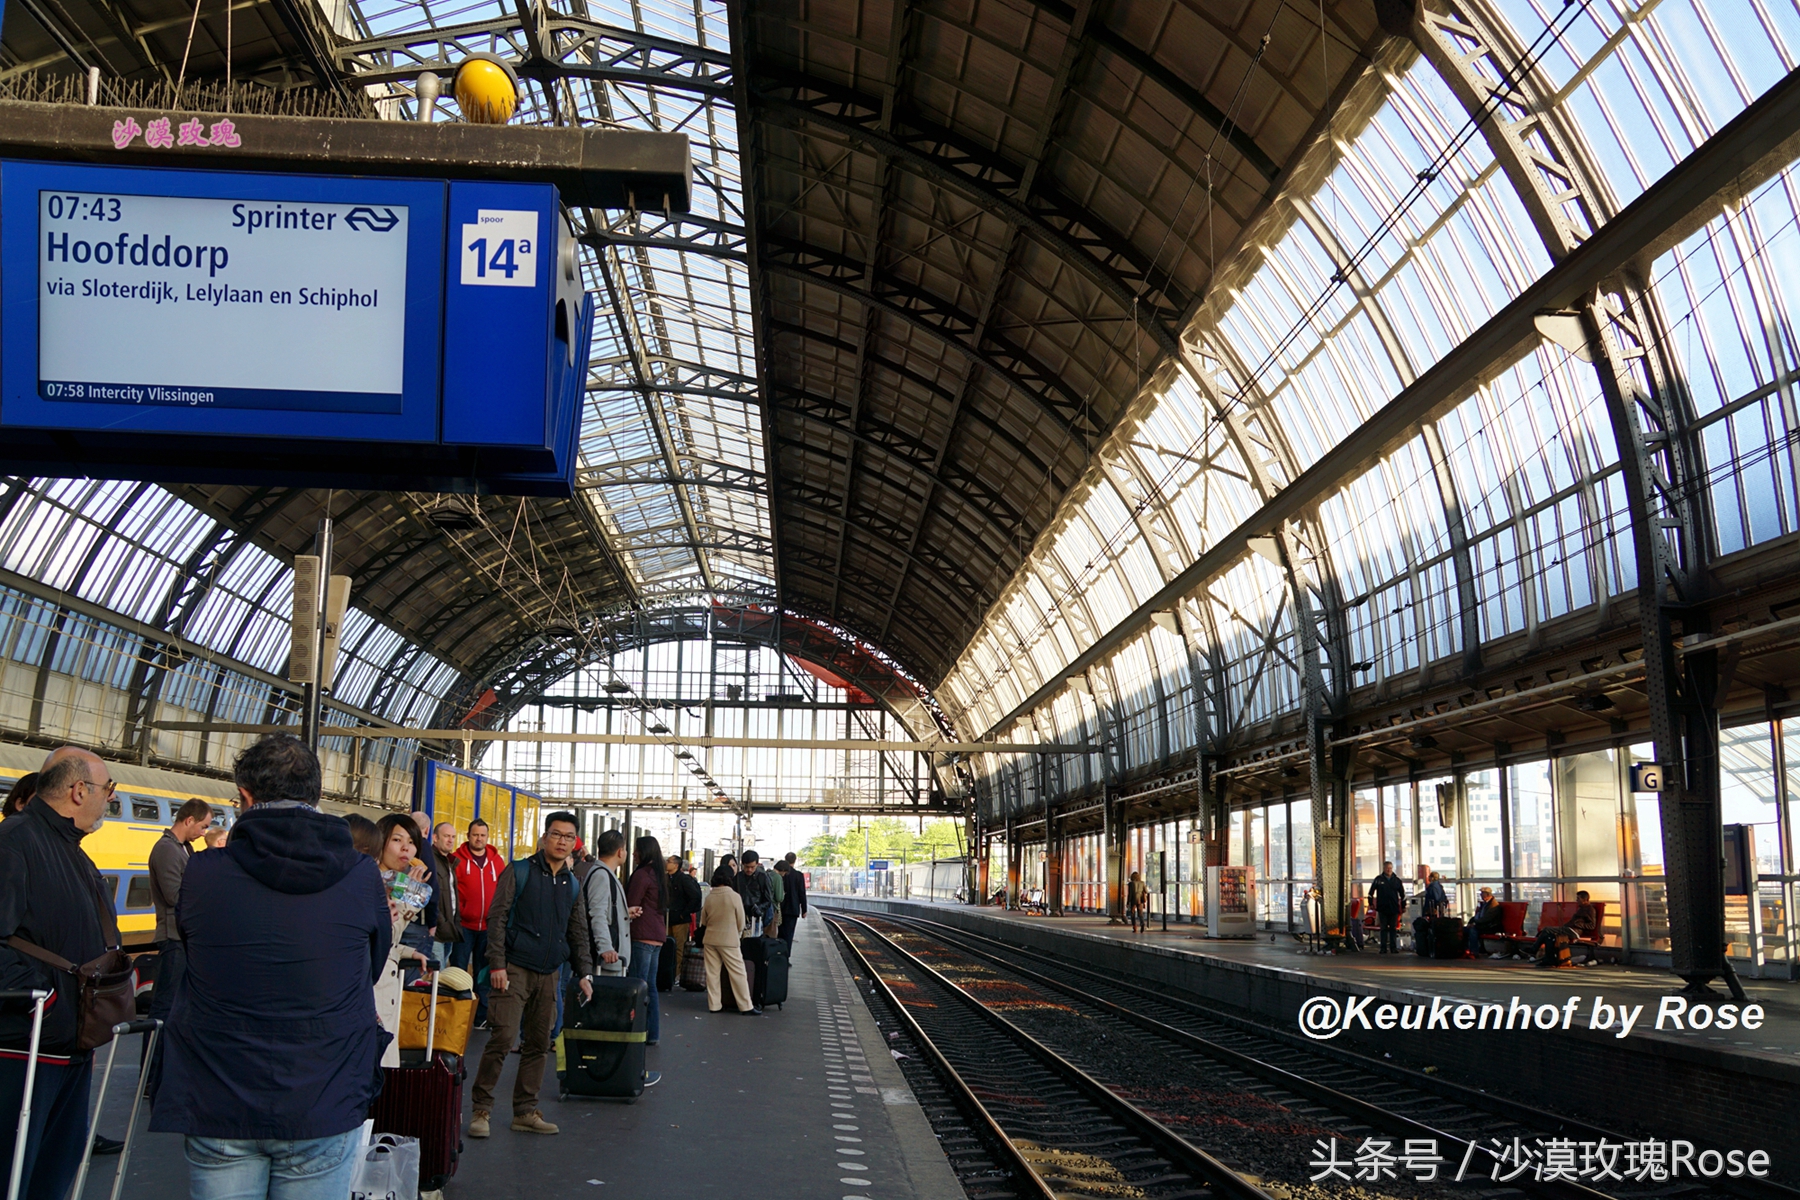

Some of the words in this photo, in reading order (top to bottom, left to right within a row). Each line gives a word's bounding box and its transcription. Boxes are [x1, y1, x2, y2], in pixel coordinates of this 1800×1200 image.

[48, 195, 122, 222] 07:43
[232, 203, 337, 235] Sprinter
[480, 216, 504, 224] spoor
[48, 231, 229, 278] Hoofddorp
[47, 277, 75, 296] via
[82, 278, 179, 304] Sloterdijk,
[186, 283, 263, 306] Lelylaan
[270, 290, 292, 304] en
[298, 287, 378, 311] Schiphol
[47, 383, 84, 397] 07:58
[88, 385, 144, 403] Intercity
[148, 387, 214, 406] Vlissingen
[1644, 772, 1658, 789] G
[679, 818, 687, 828] G
[415, 1025, 447, 1035] GOIVA
